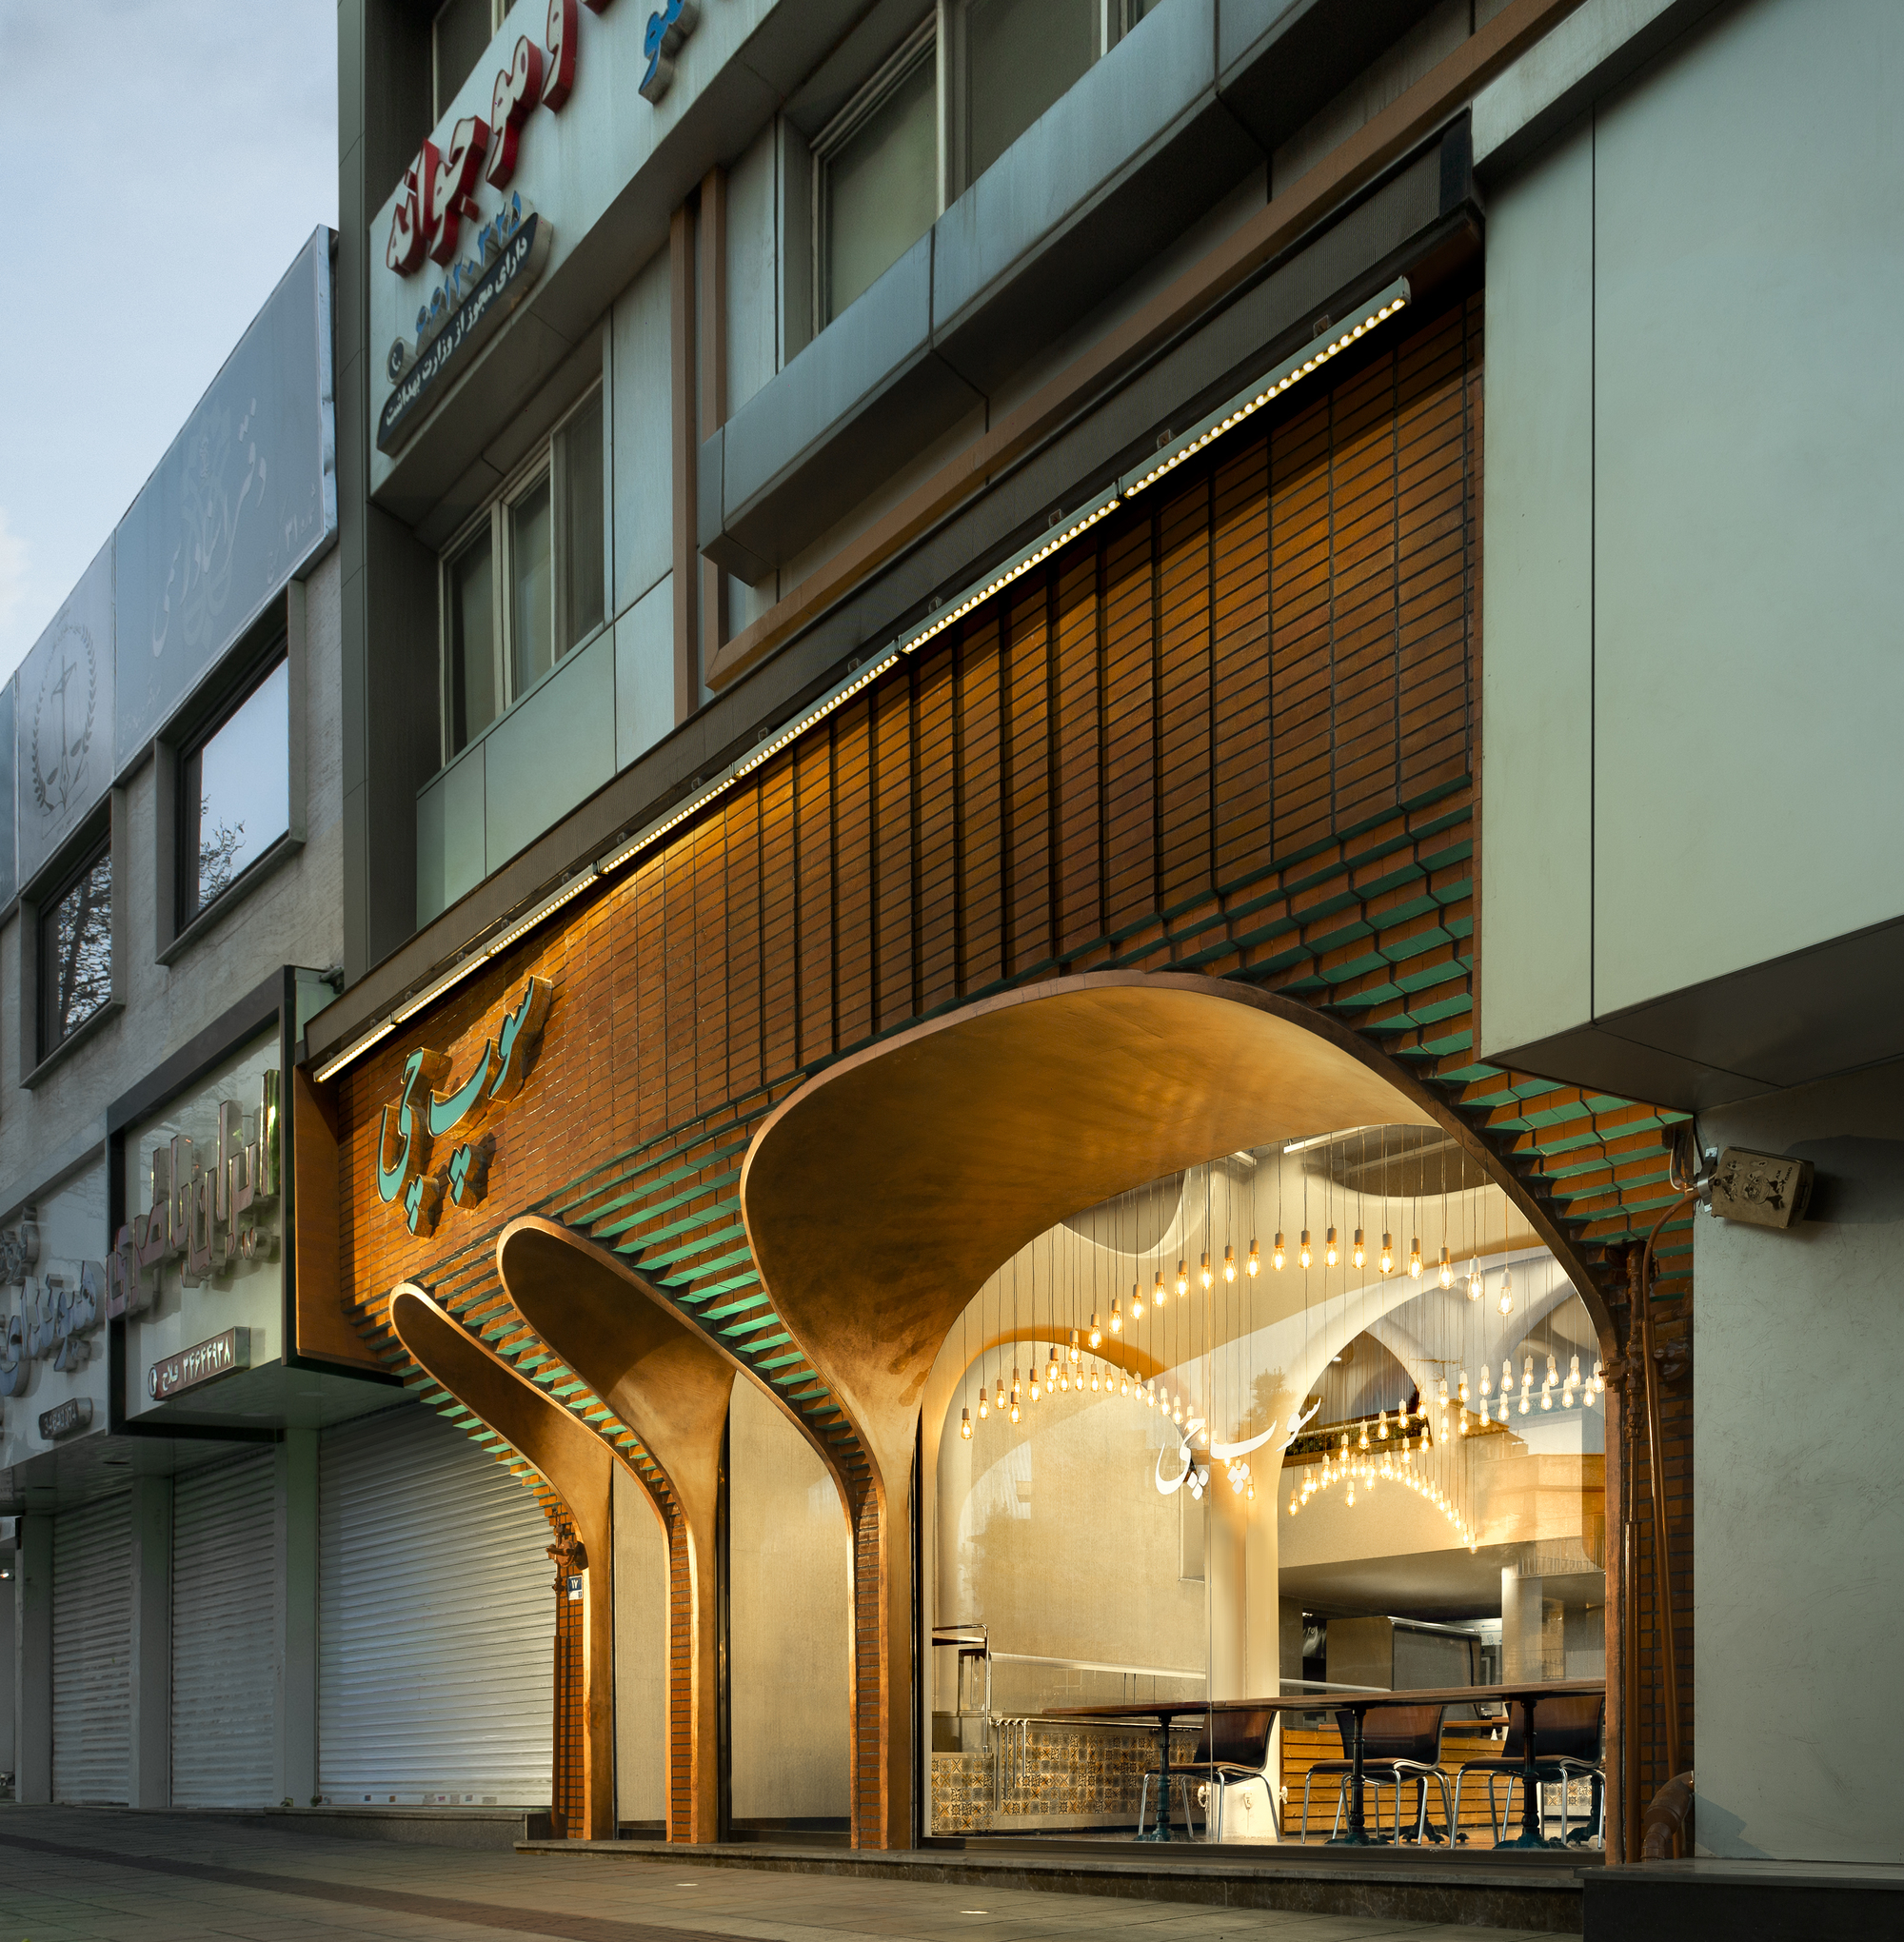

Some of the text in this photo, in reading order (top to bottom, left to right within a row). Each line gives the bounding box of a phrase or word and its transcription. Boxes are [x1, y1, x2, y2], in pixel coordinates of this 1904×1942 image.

[486, 35, 531, 184] مو
[386, 236, 527, 426] دارای مجوز از وزارت بهداشت
[224, 397, 267, 573] دفتر
[188, 1068, 272, 1278] ایران
